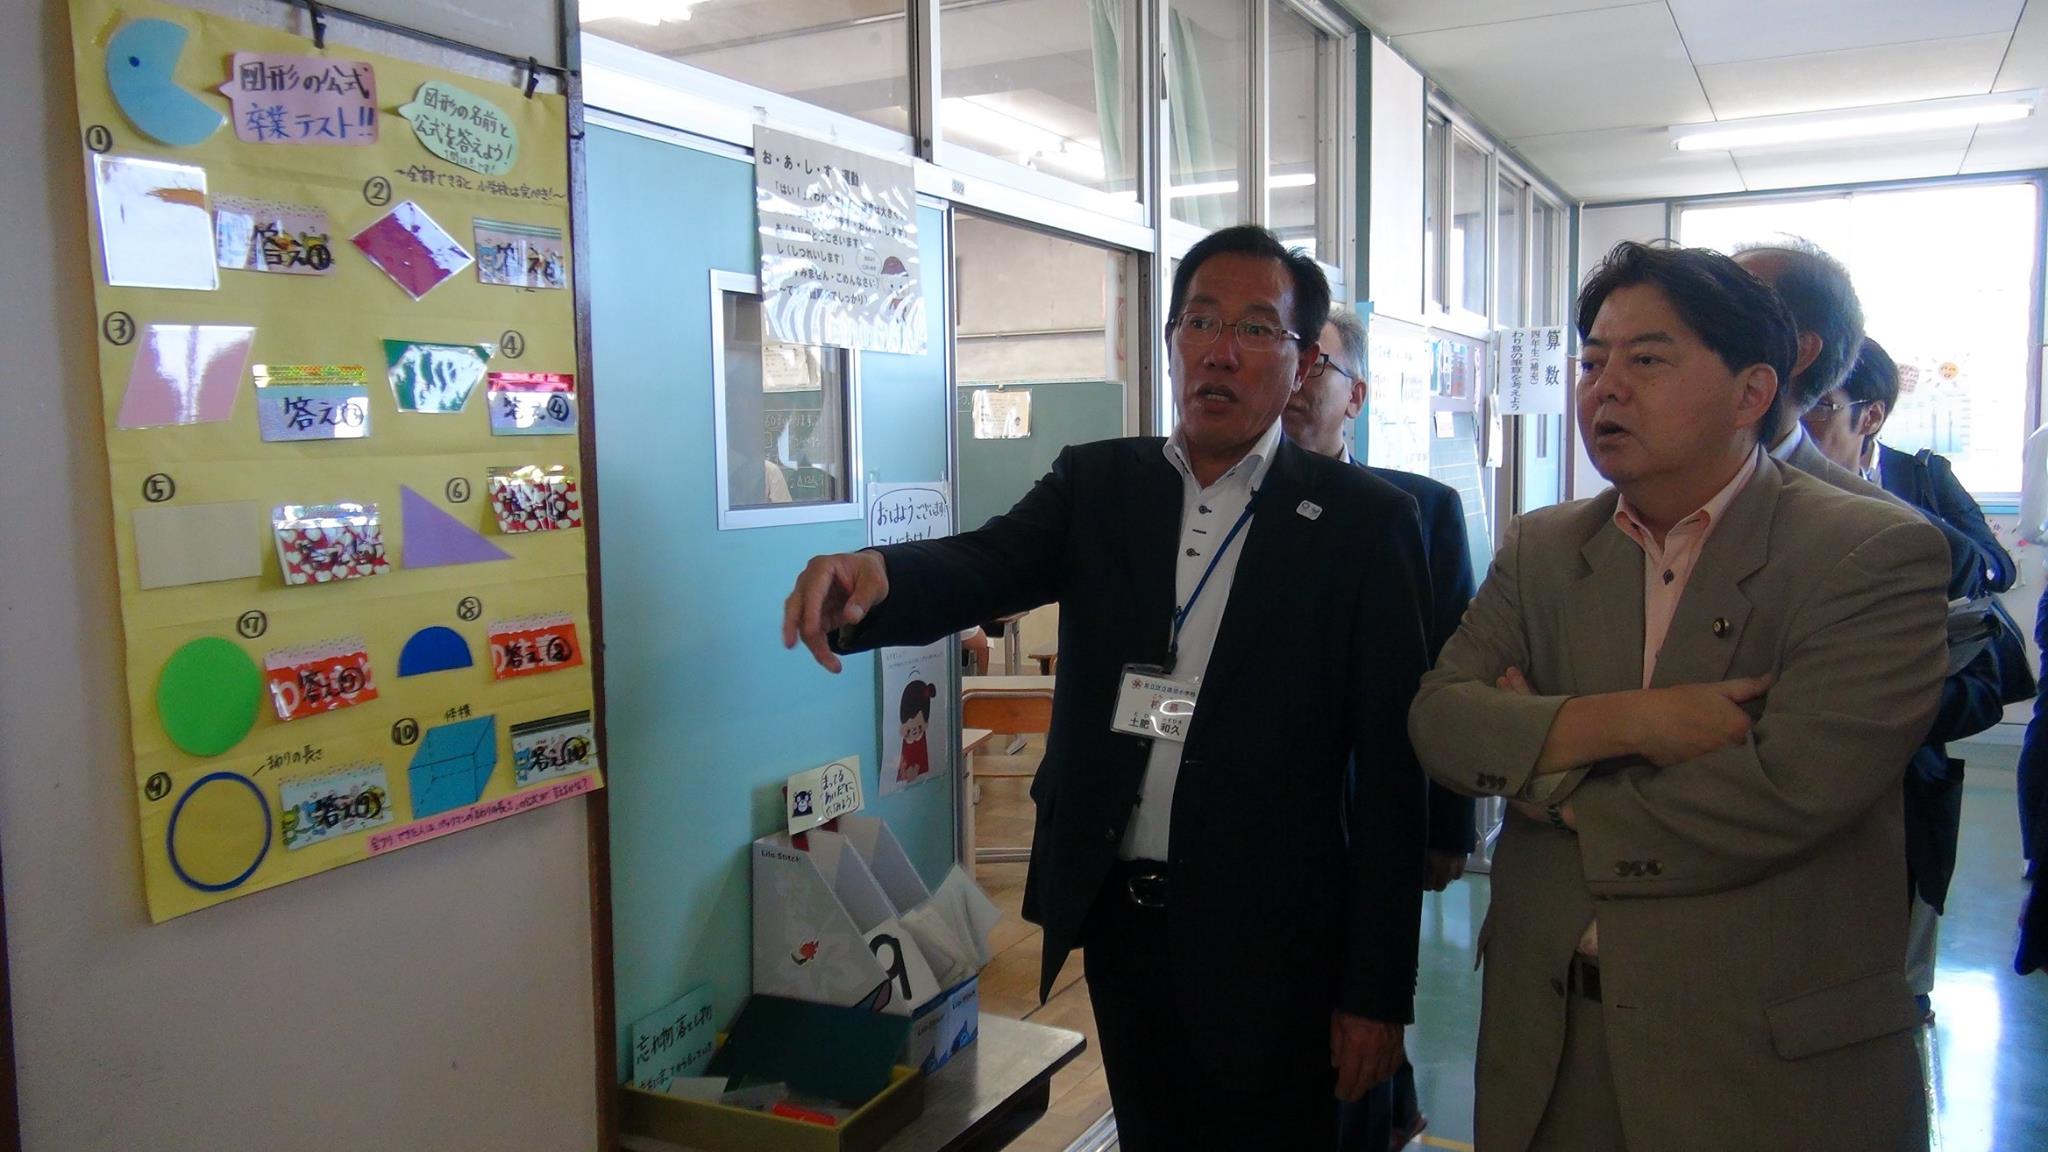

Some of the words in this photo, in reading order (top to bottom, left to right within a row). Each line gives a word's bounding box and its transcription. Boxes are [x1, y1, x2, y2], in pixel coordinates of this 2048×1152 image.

[424, 87, 511, 139] 図形の名前と
